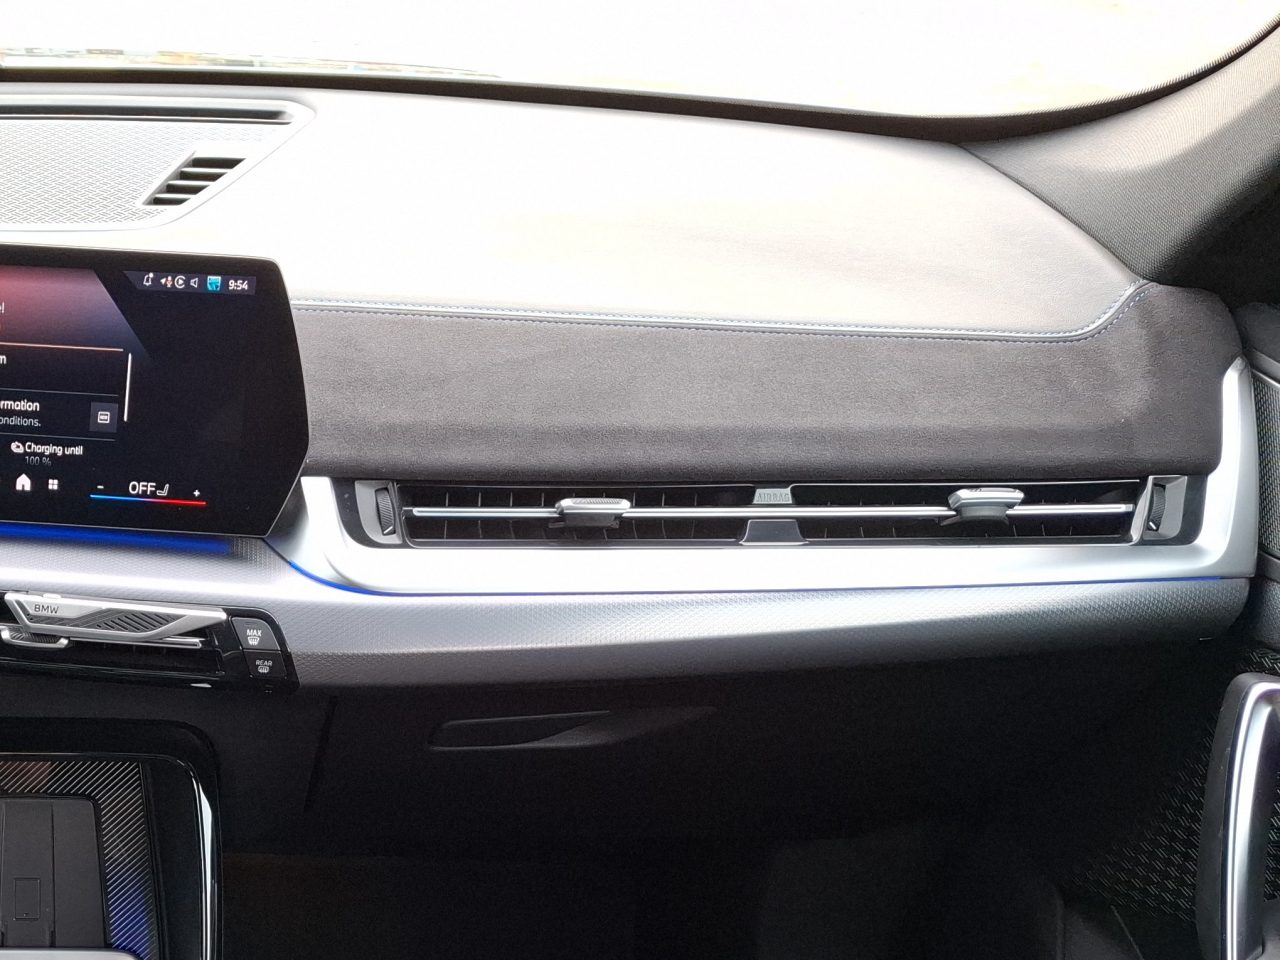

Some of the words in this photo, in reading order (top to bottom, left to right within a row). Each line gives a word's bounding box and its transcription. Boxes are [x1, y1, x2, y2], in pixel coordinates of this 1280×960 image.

[228, 279, 249, 291] 9:54
[24, 442, 63, 456] Charging
[64, 445, 84, 456] until
[24, 455, 40, 466] 100
[128, 481, 157, 495] OFF
[756, 492, 790, 503] AIRBAG
[33, 603, 60, 615] BMW
[246, 628, 262, 637] MAX
[255, 659, 273, 667] REAR
